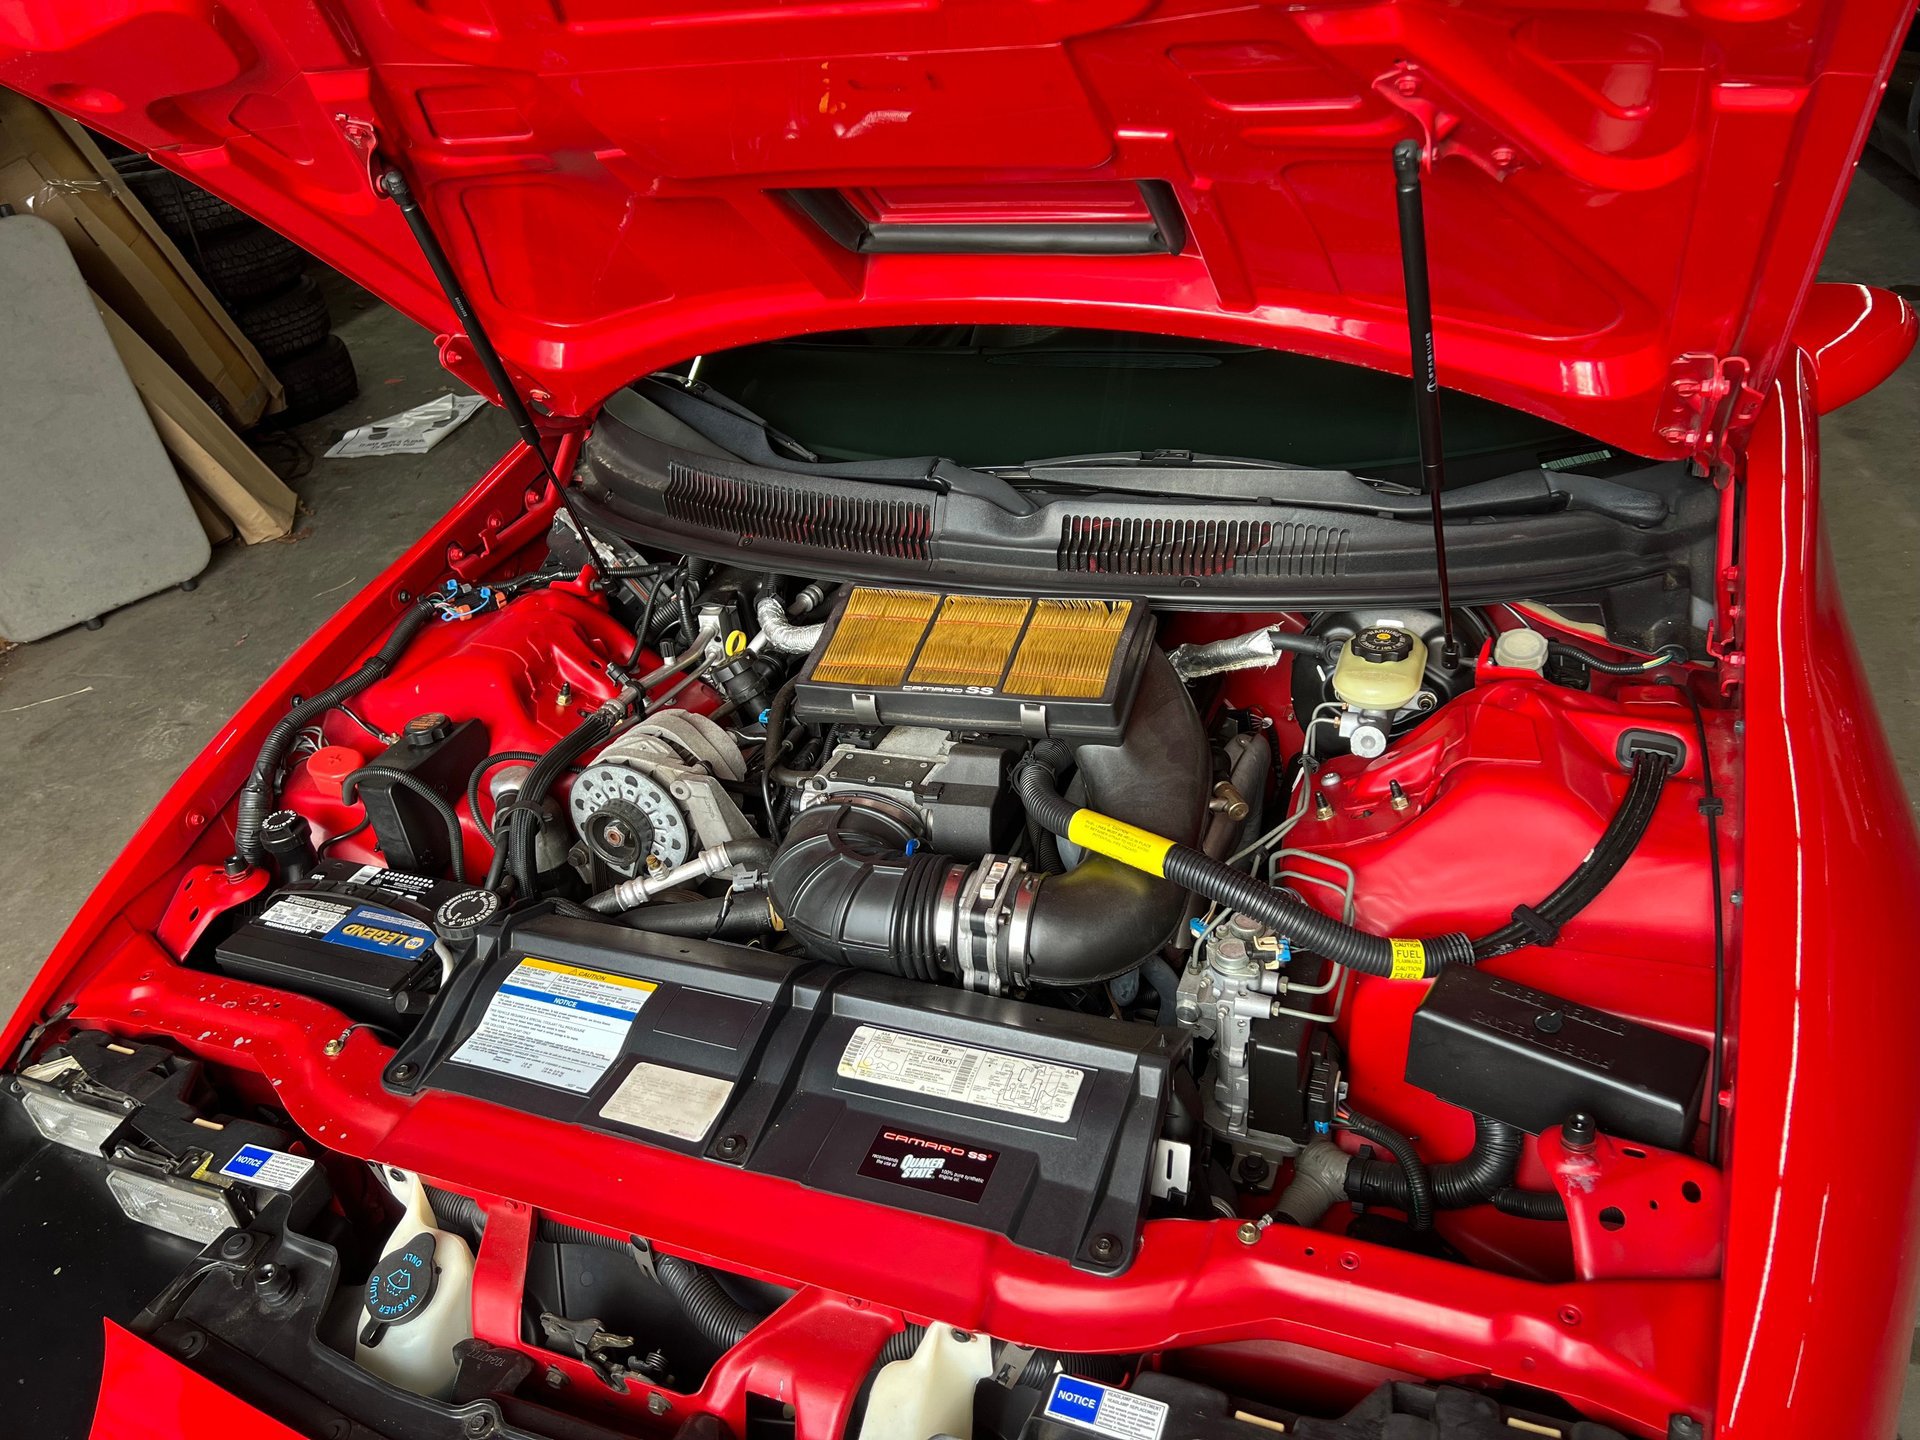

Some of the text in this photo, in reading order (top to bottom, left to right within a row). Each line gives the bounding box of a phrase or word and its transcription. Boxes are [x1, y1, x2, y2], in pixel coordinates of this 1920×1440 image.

[1425, 332, 1434, 380] STABILUS
[902, 685, 994, 695] CAMARO SS
[341, 924, 409, 946] LEGEND
[1397, 950, 1421, 958] FUEL
[579, 971, 606, 981] CAUTION
[553, 997, 578, 1008] NOTICE
[927, 1055, 957, 1065] CATALYST
[883, 1132, 965, 1156] CAMARO
[236, 1155, 263, 1168] NOTICE
[872, 1153, 898, 1162] recommends
[900, 1154, 946, 1170] QUAKER
[901, 1168, 935, 1178] STATE
[965, 1174, 984, 1183] synthetic
[402, 1252, 423, 1268] ONLY
[369, 1275, 418, 1315] WASHER FLUID
[1058, 1390, 1097, 1409] NOTICE
[1108, 1392, 1162, 1411] HEADLAMP ADJUSTMENT
[1107, 1398, 1159, 1416] HEADLAMP REPLACEMENT
